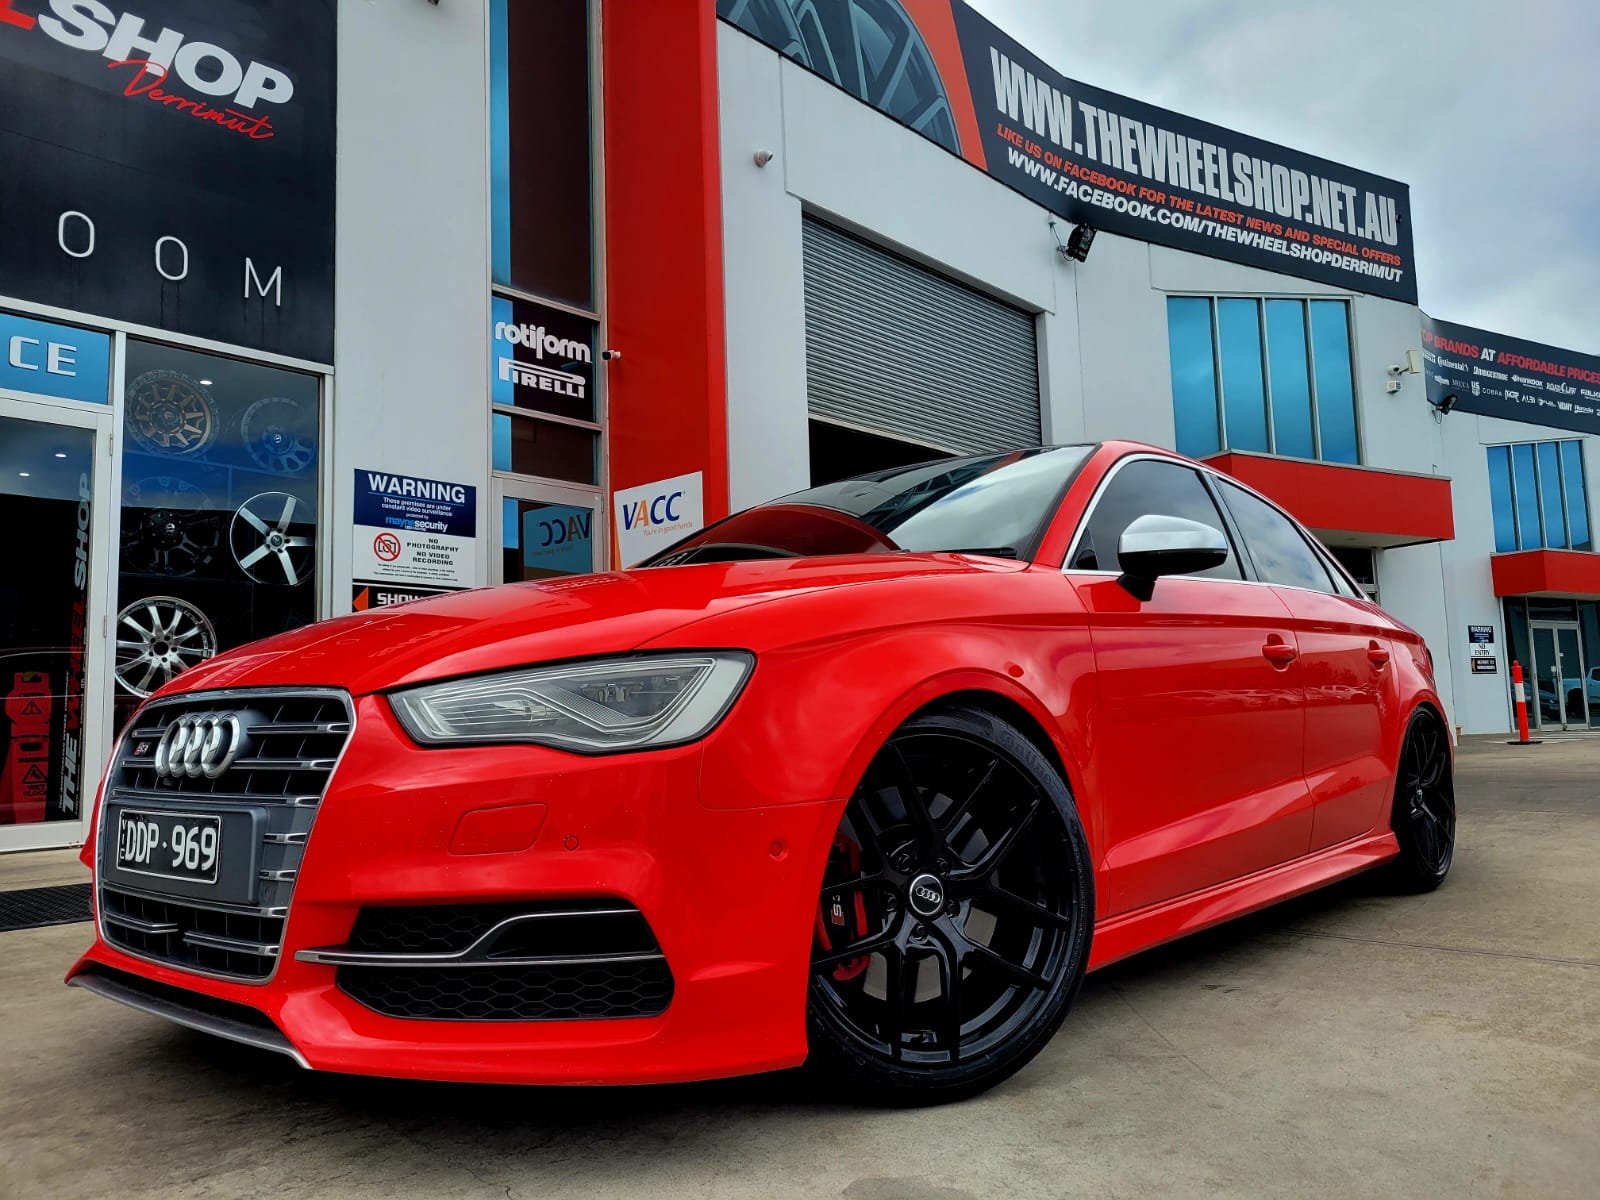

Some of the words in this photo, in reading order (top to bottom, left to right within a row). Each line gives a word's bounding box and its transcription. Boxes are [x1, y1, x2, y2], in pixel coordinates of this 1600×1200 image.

[38, 0, 294, 109] SHOP
[990, 46, 1398, 246] WWW.THEWHEELSHOP.NET.AU
[997, 123, 1024, 148] LIKE
[1024, 139, 1042, 159] US
[1043, 151, 1062, 169] ON
[1063, 161, 1137, 197] FACEBOOK
[1138, 187, 1166, 205] FOR
[1169, 195, 1195, 212] THE
[1196, 203, 1245, 225] LATEST
[1245, 217, 1283, 236] NEWS
[1284, 227, 1311, 244] AND
[1312, 234, 1359, 255] SPECIAL
[1361, 247, 1401, 266] OFFERS
[1008, 146, 1403, 283] WWW.FACEBOOK.COM/THEWHEELSHOPDERRIMUT
[495, 321, 592, 363] rotiform
[1433, 336, 1480, 358] BRANDS
[1480, 347, 1496, 362] AT
[1497, 351, 1566, 377] AFFORDABLE
[498, 356, 586, 399] PIRELLI
[368, 473, 465, 503] WARNING
[400, 499, 426, 509] premises
[381, 503, 406, 511] constant
[406, 505, 421, 513] video
[421, 508, 453, 517] surveillance
[622, 491, 682, 530] VACC
[406, 542, 459, 552] PHOTOGRAPHY
[412, 557, 454, 566] RECORDING
[428, 551, 450, 559] VIDEO
[62, 732, 78, 814] THE
[74, 472, 91, 591] SHOP
